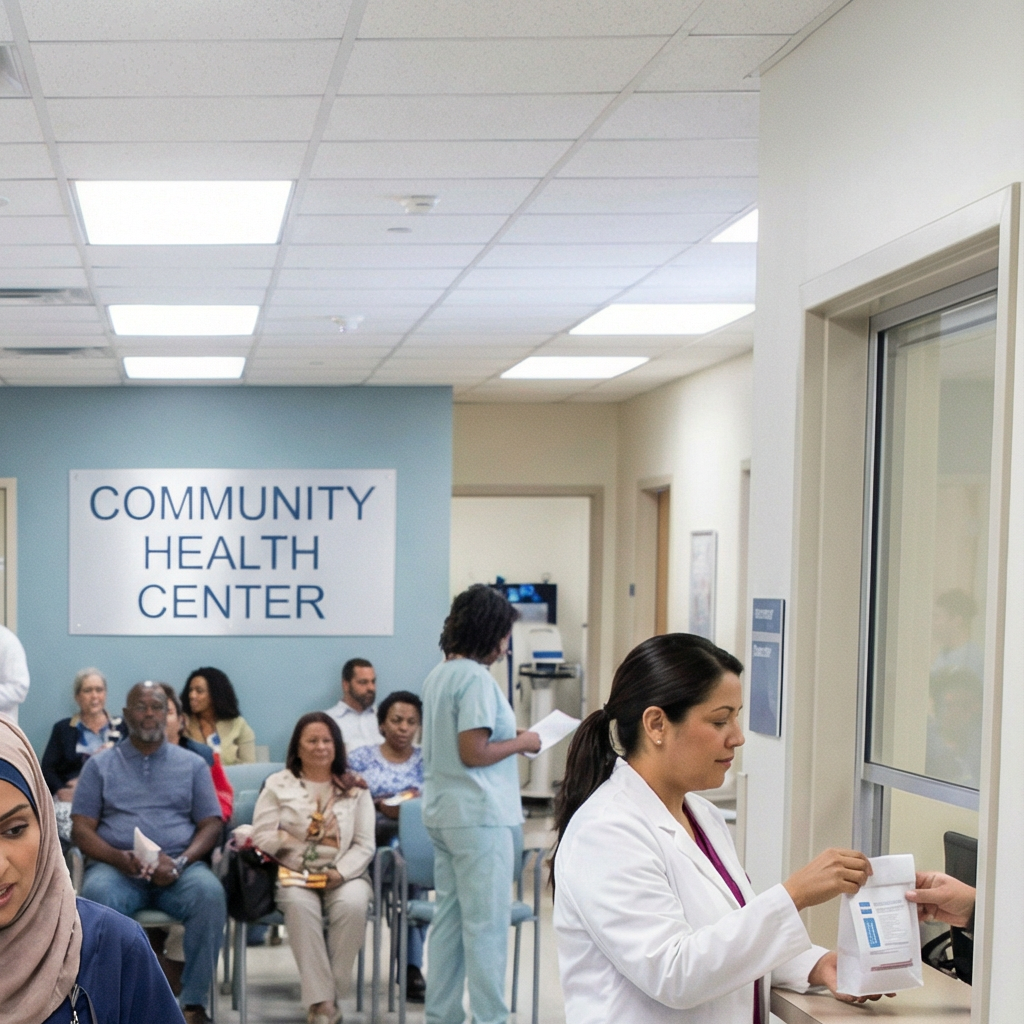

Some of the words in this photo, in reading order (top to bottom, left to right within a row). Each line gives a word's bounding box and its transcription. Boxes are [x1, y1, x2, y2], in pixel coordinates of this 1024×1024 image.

[89, 485, 376, 521] COMMUNITY
[144, 535, 320, 570] HEALTH
[137, 584, 325, 619] CENTER
